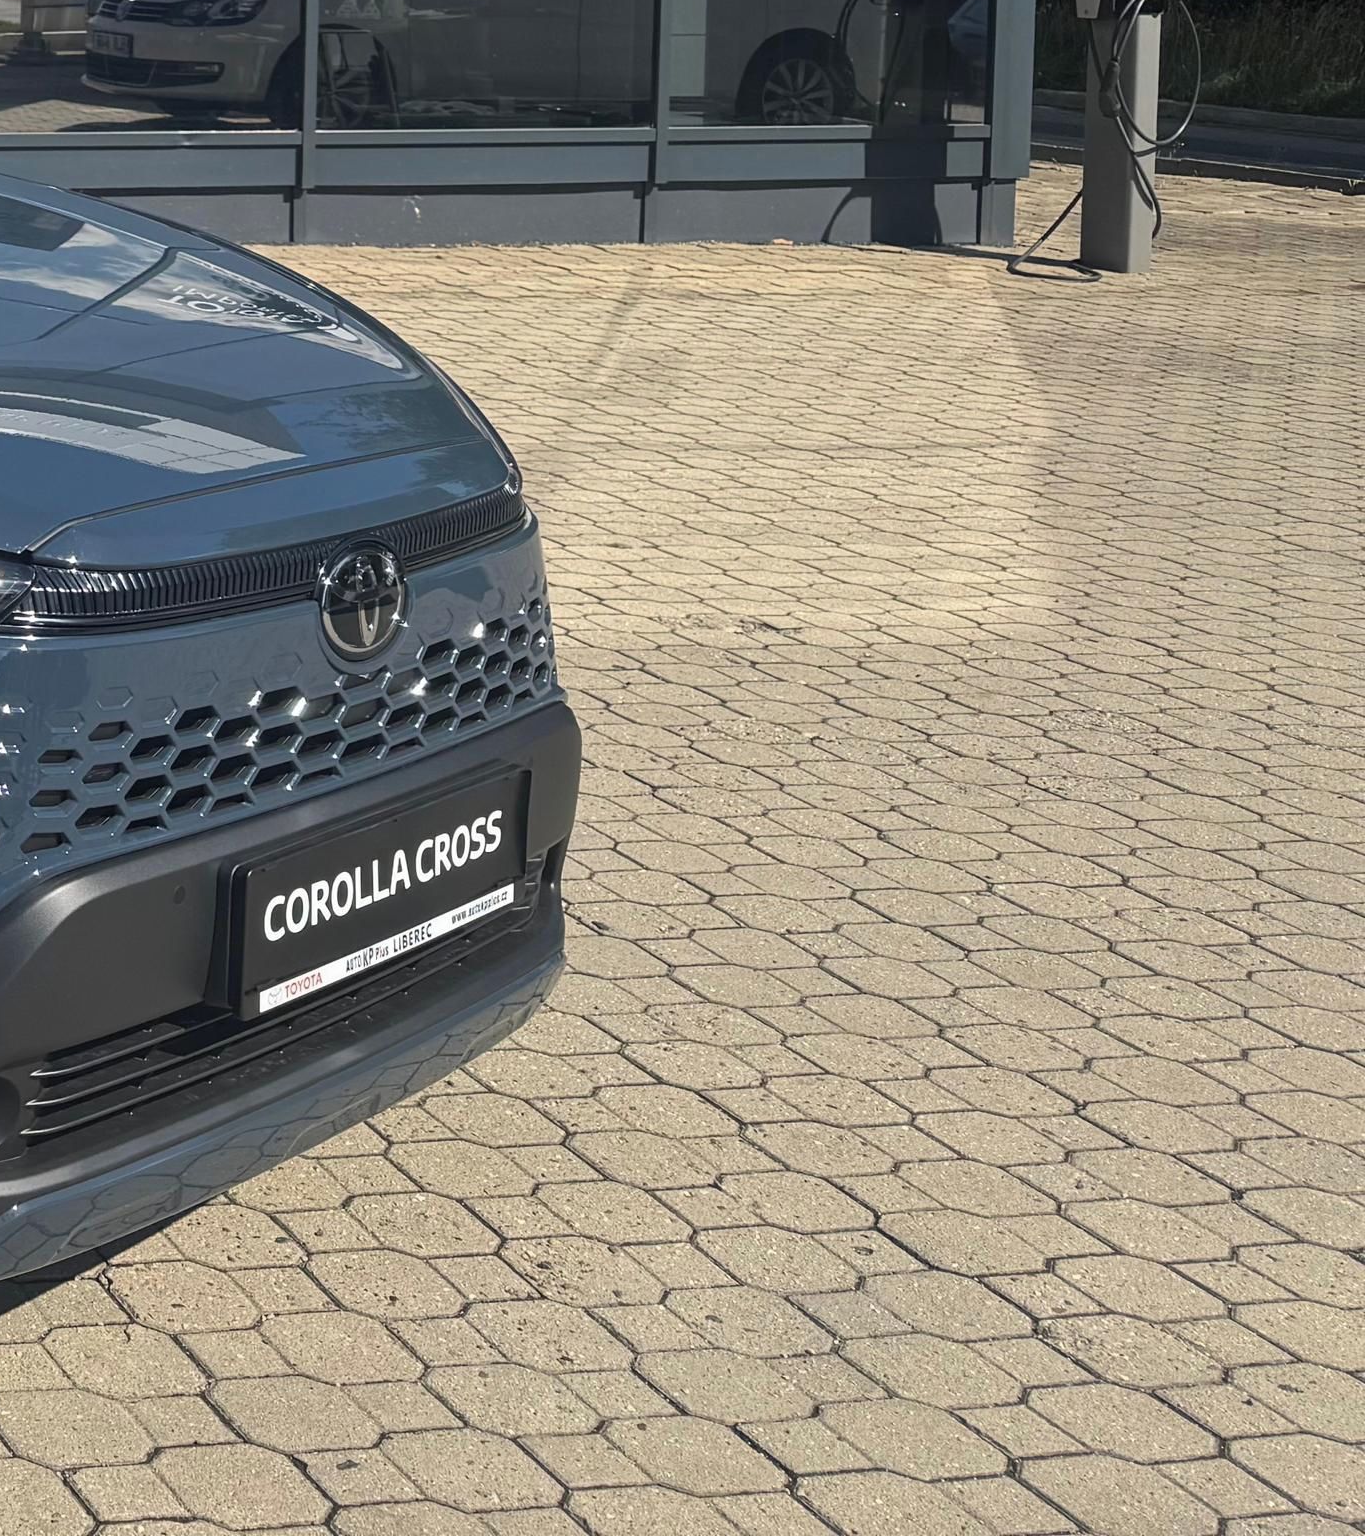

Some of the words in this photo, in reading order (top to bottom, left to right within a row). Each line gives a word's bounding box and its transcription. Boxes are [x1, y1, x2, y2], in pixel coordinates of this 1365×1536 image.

[263, 848, 411, 942] COROLLA
[415, 809, 503, 883] CROSS
[284, 971, 324, 999] TOYOTA
[363, 947, 374, 967] KP
[393, 922, 433, 954] LIBEREC
